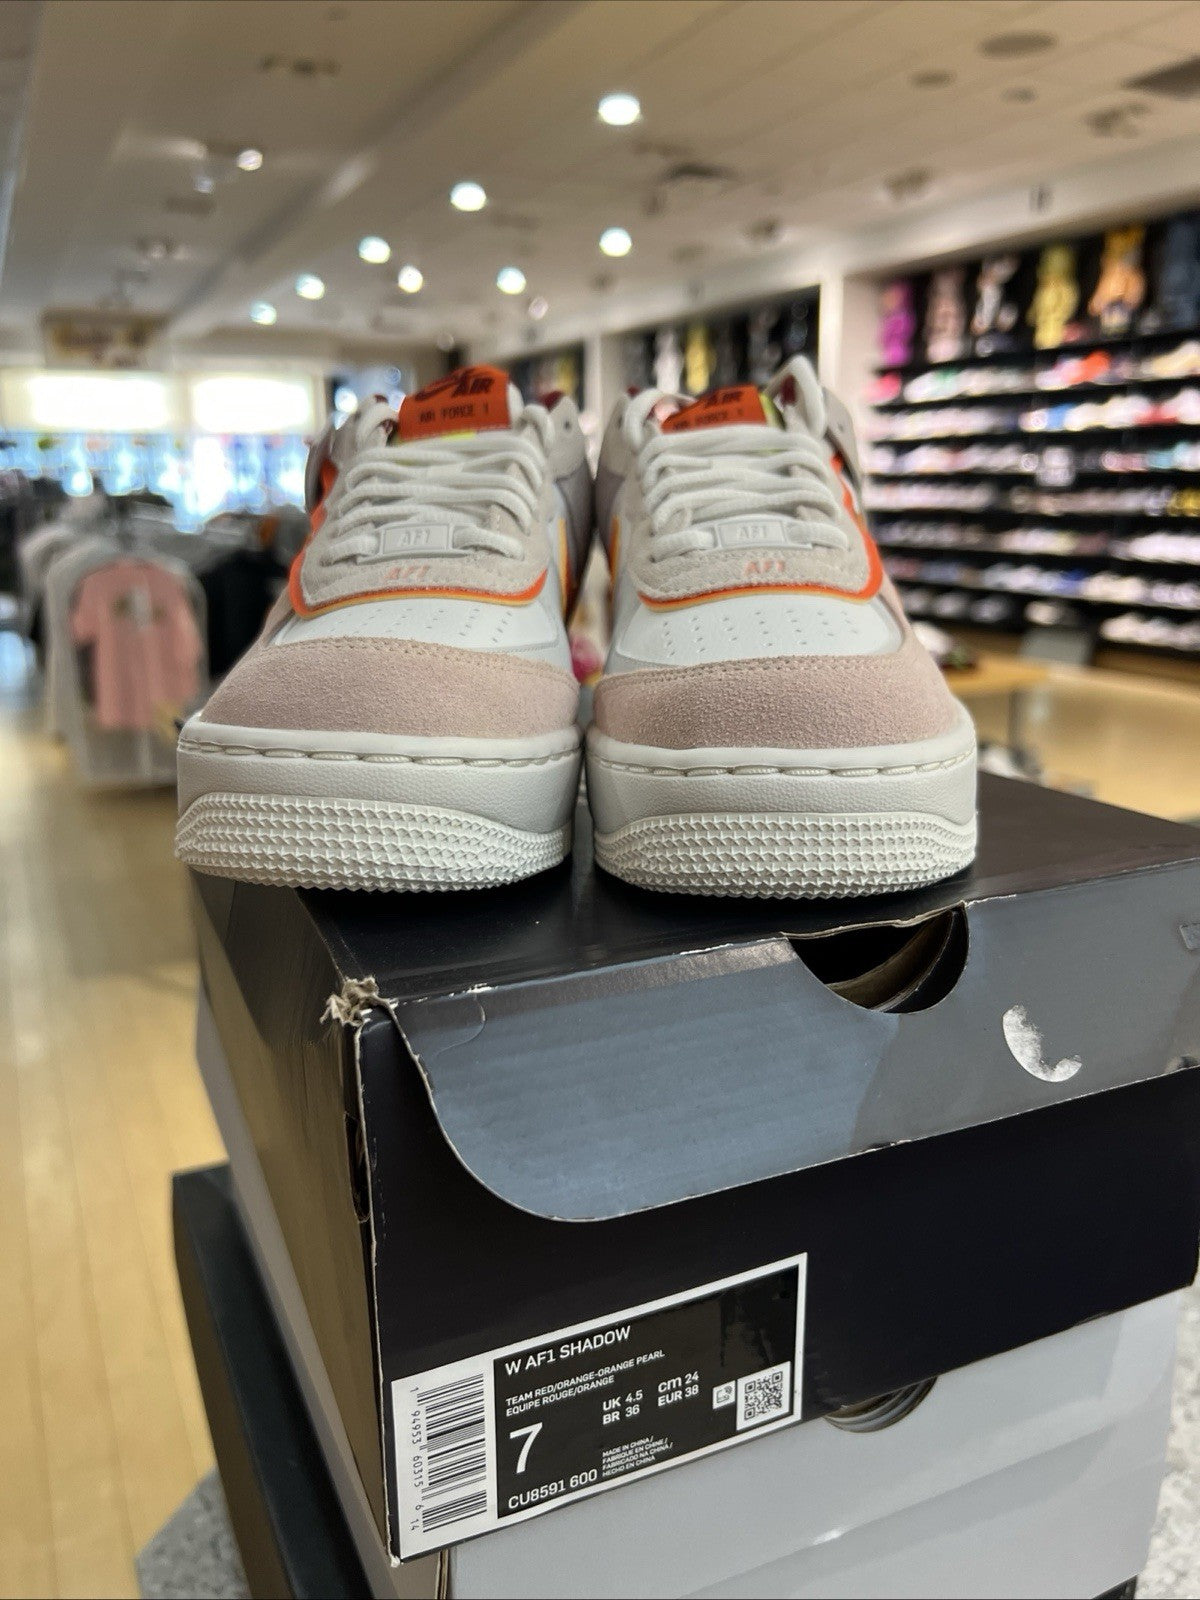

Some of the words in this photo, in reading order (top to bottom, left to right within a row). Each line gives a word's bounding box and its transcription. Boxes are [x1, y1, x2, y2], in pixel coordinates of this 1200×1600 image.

[505, 1358, 522, 1376] W
[525, 1348, 556, 1370] AF1
[559, 1325, 631, 1359] SHADOW
[506, 1390, 533, 1406] TEAM
[534, 1358, 635, 1398] RED/ORANGE-ORANGE
[636, 1349, 666, 1366] PEARL
[657, 1376, 682, 1393] cm
[684, 1370, 700, 1385] 24
[506, 1399, 541, 1417] EQUIPE
[542, 1375, 615, 1405] ROUGE/ORANGE
[602, 1396, 622, 1412] UK
[625, 1389, 644, 1404] 4.5
[657, 1390, 683, 1407] EUR
[684, 1384, 700, 1399] 38
[602, 1411, 621, 1426] BR
[625, 1404, 641, 1418] 36
[411, 1410, 422, 1445] 94953
[509, 1421, 543, 1475] 7
[602, 1447, 621, 1458] MADE
[639, 1451, 649, 1459] NA
[412, 1455, 424, 1488] 60315
[625, 1462, 635, 1470] EN
[508, 1479, 566, 1509] CU8591
[569, 1468, 598, 1488] 600
[410, 1518, 419, 1531] 14
